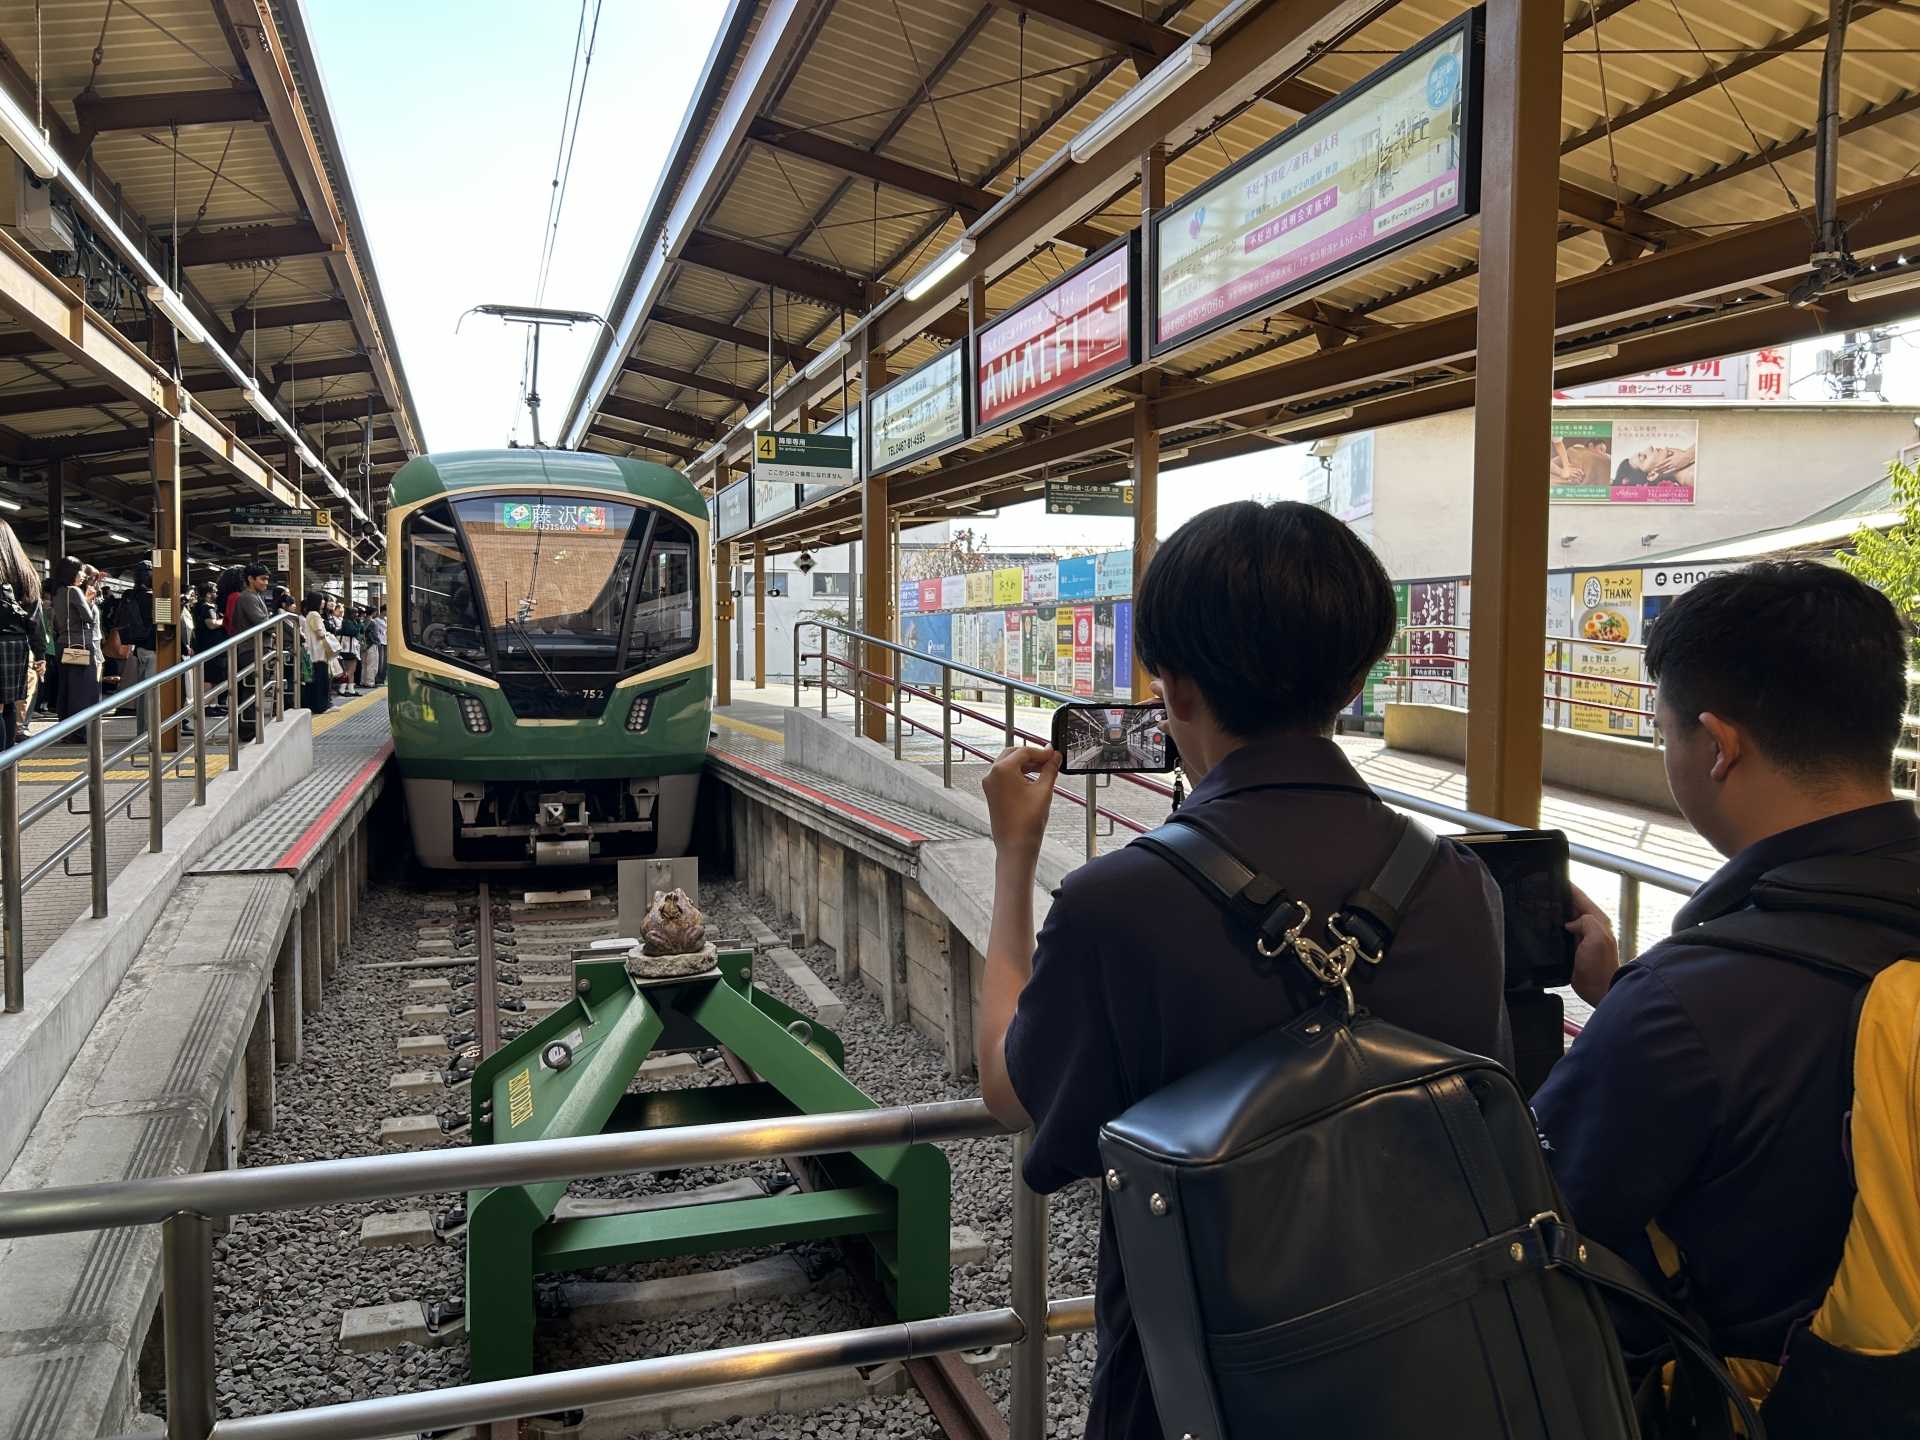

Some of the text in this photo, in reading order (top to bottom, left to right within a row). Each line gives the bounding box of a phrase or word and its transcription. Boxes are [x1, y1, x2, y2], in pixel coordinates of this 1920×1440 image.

[984, 315, 1080, 411] AMALFI
[1617, 384, 1693, 394] 鎌倉シーサイド店
[759, 439, 772, 455] 4
[1125, 487, 1134, 501] 5
[319, 512, 328, 524] 3
[532, 504, 578, 525] 藤沢
[533, 523, 577, 532] FUJISAWA
[1604, 578, 1632, 586] ラーメン
[1604, 588, 1632, 599] THANK
[582, 689, 604, 698] 752
[508, 1068, 534, 1128] ENODEN
